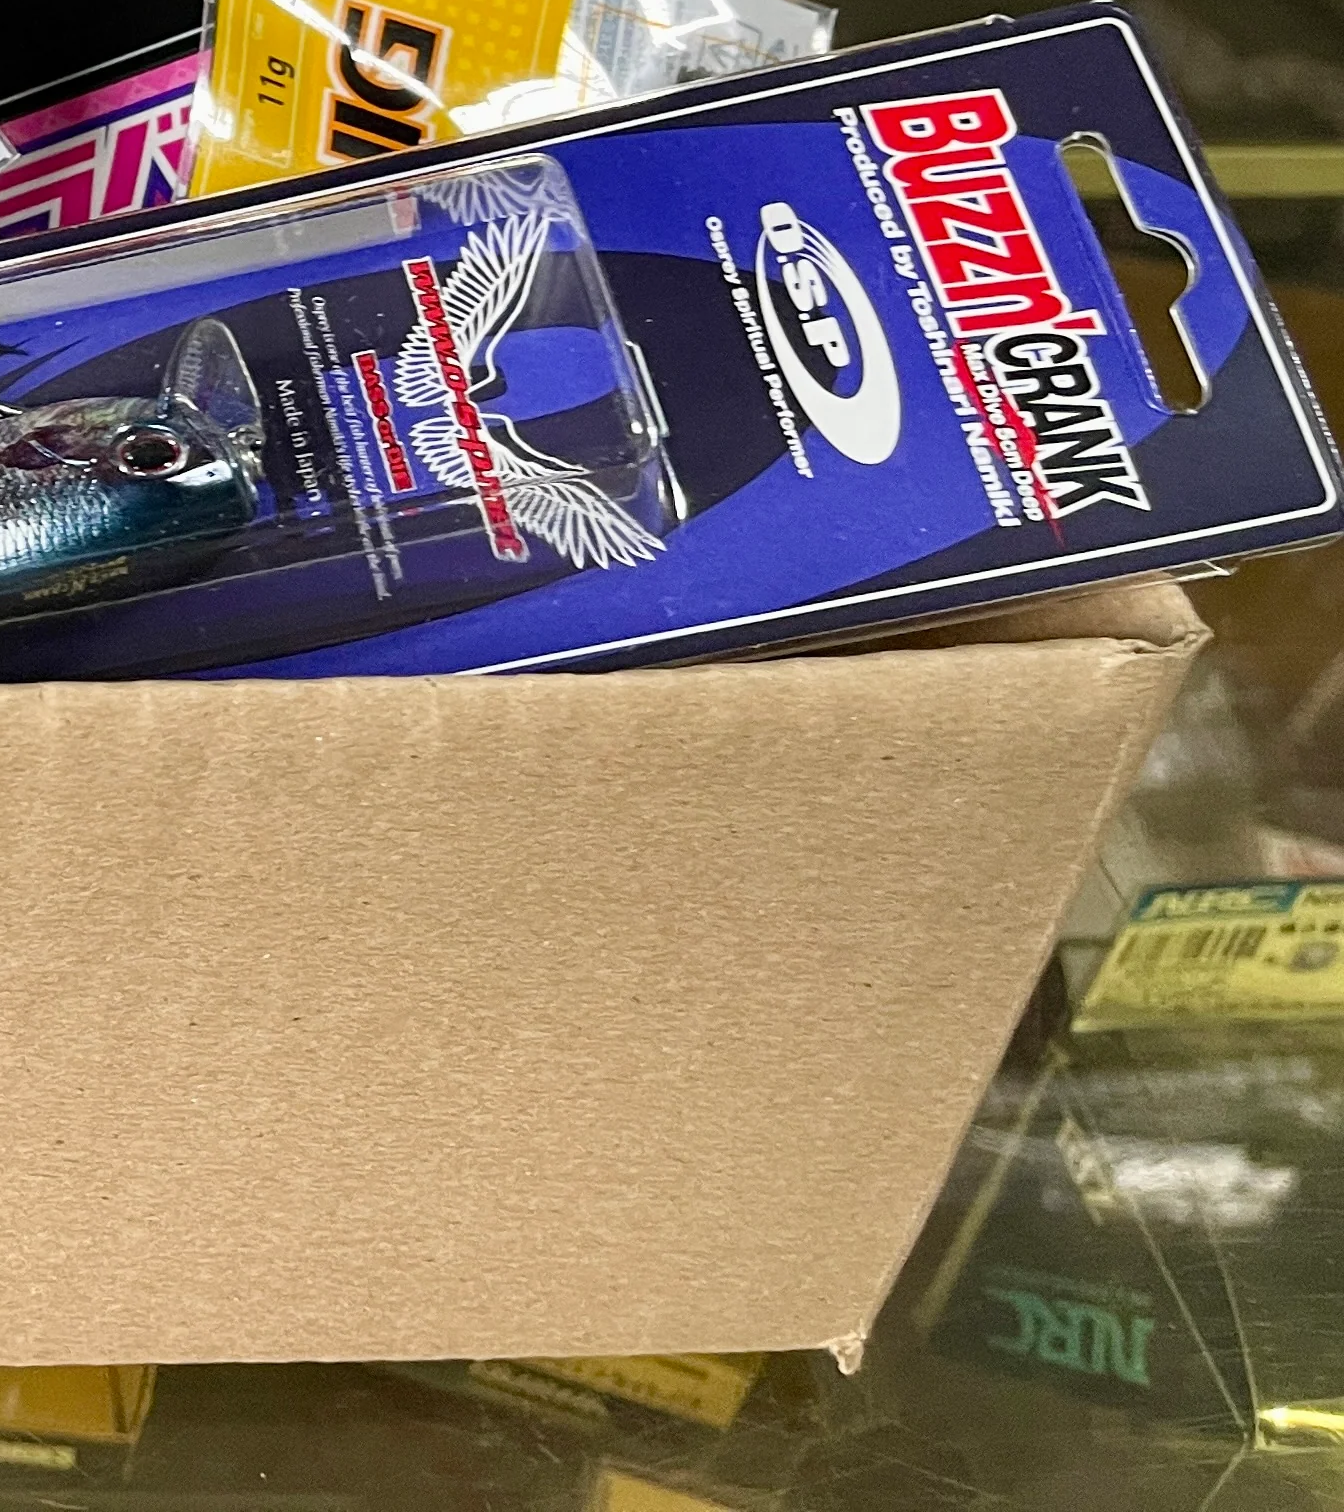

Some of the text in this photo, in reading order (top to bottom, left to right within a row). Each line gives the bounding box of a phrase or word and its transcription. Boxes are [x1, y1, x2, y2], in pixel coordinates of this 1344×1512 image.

[256, 53, 297, 107] 11g
[704, 214, 815, 480] Osprey Spiritual Performer
[759, 201, 852, 369] O.S.P
[832, 106, 1023, 529] Produced by Toshinari Namiki
[274, 377, 303, 431] Made
[294, 450, 325, 504] Japan
[959, 341, 1045, 523] Max Dive Deep
[988, 330, 1151, 518] CRANK
